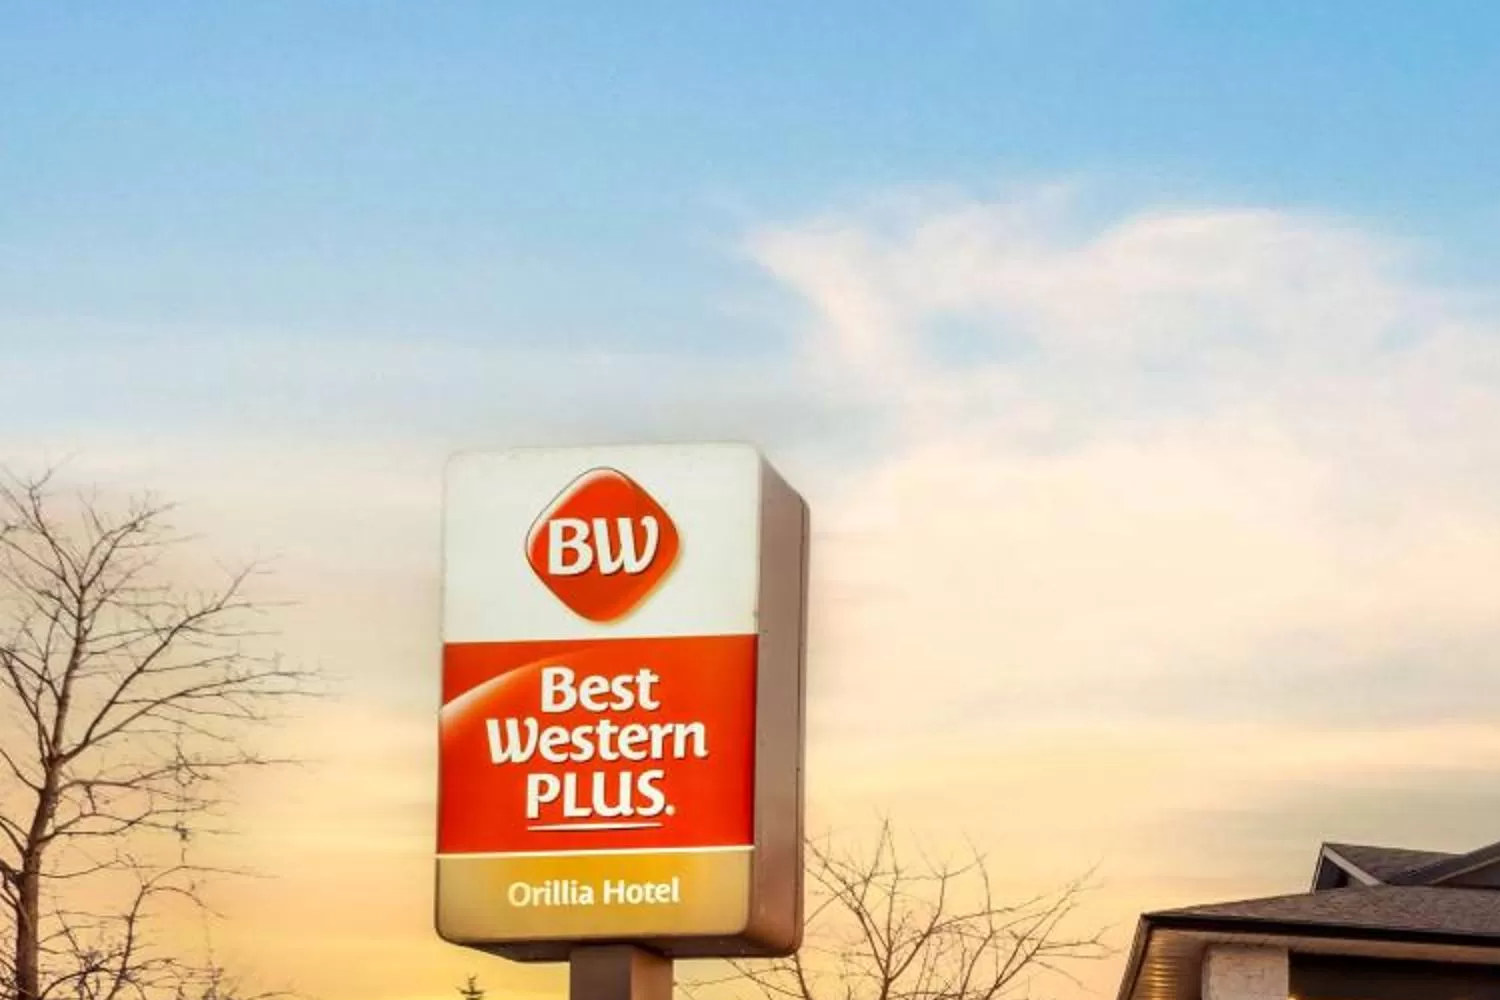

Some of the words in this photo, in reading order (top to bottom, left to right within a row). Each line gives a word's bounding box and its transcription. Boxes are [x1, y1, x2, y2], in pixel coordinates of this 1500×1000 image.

[548, 516, 659, 576] BW
[541, 667, 660, 713] Best
[486, 717, 708, 763] Western
[508, 879, 594, 906] Orillia
[603, 877, 680, 905] Hotel
